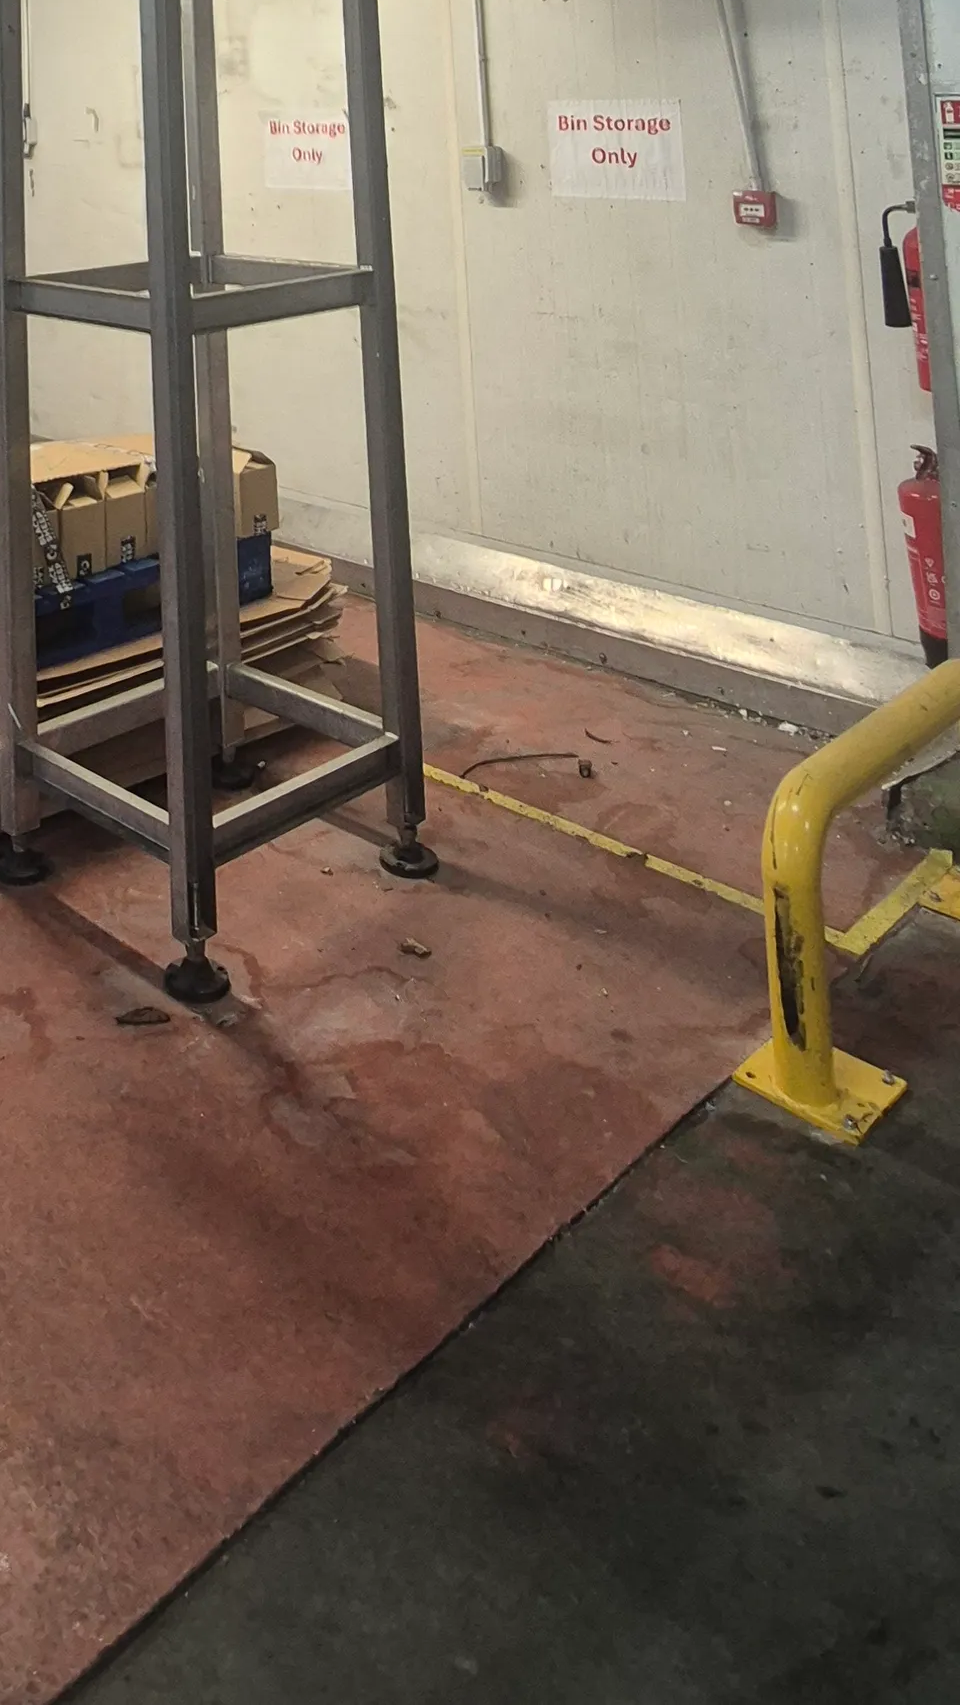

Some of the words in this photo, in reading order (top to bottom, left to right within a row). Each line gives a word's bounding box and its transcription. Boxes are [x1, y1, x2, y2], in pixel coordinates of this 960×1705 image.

[269, 119, 290, 135] Bin
[293, 119, 345, 138] Storage
[558, 115, 587, 131] Bin
[593, 114, 671, 135] Storage
[292, 147, 323, 164] Only
[592, 147, 637, 168] Only
